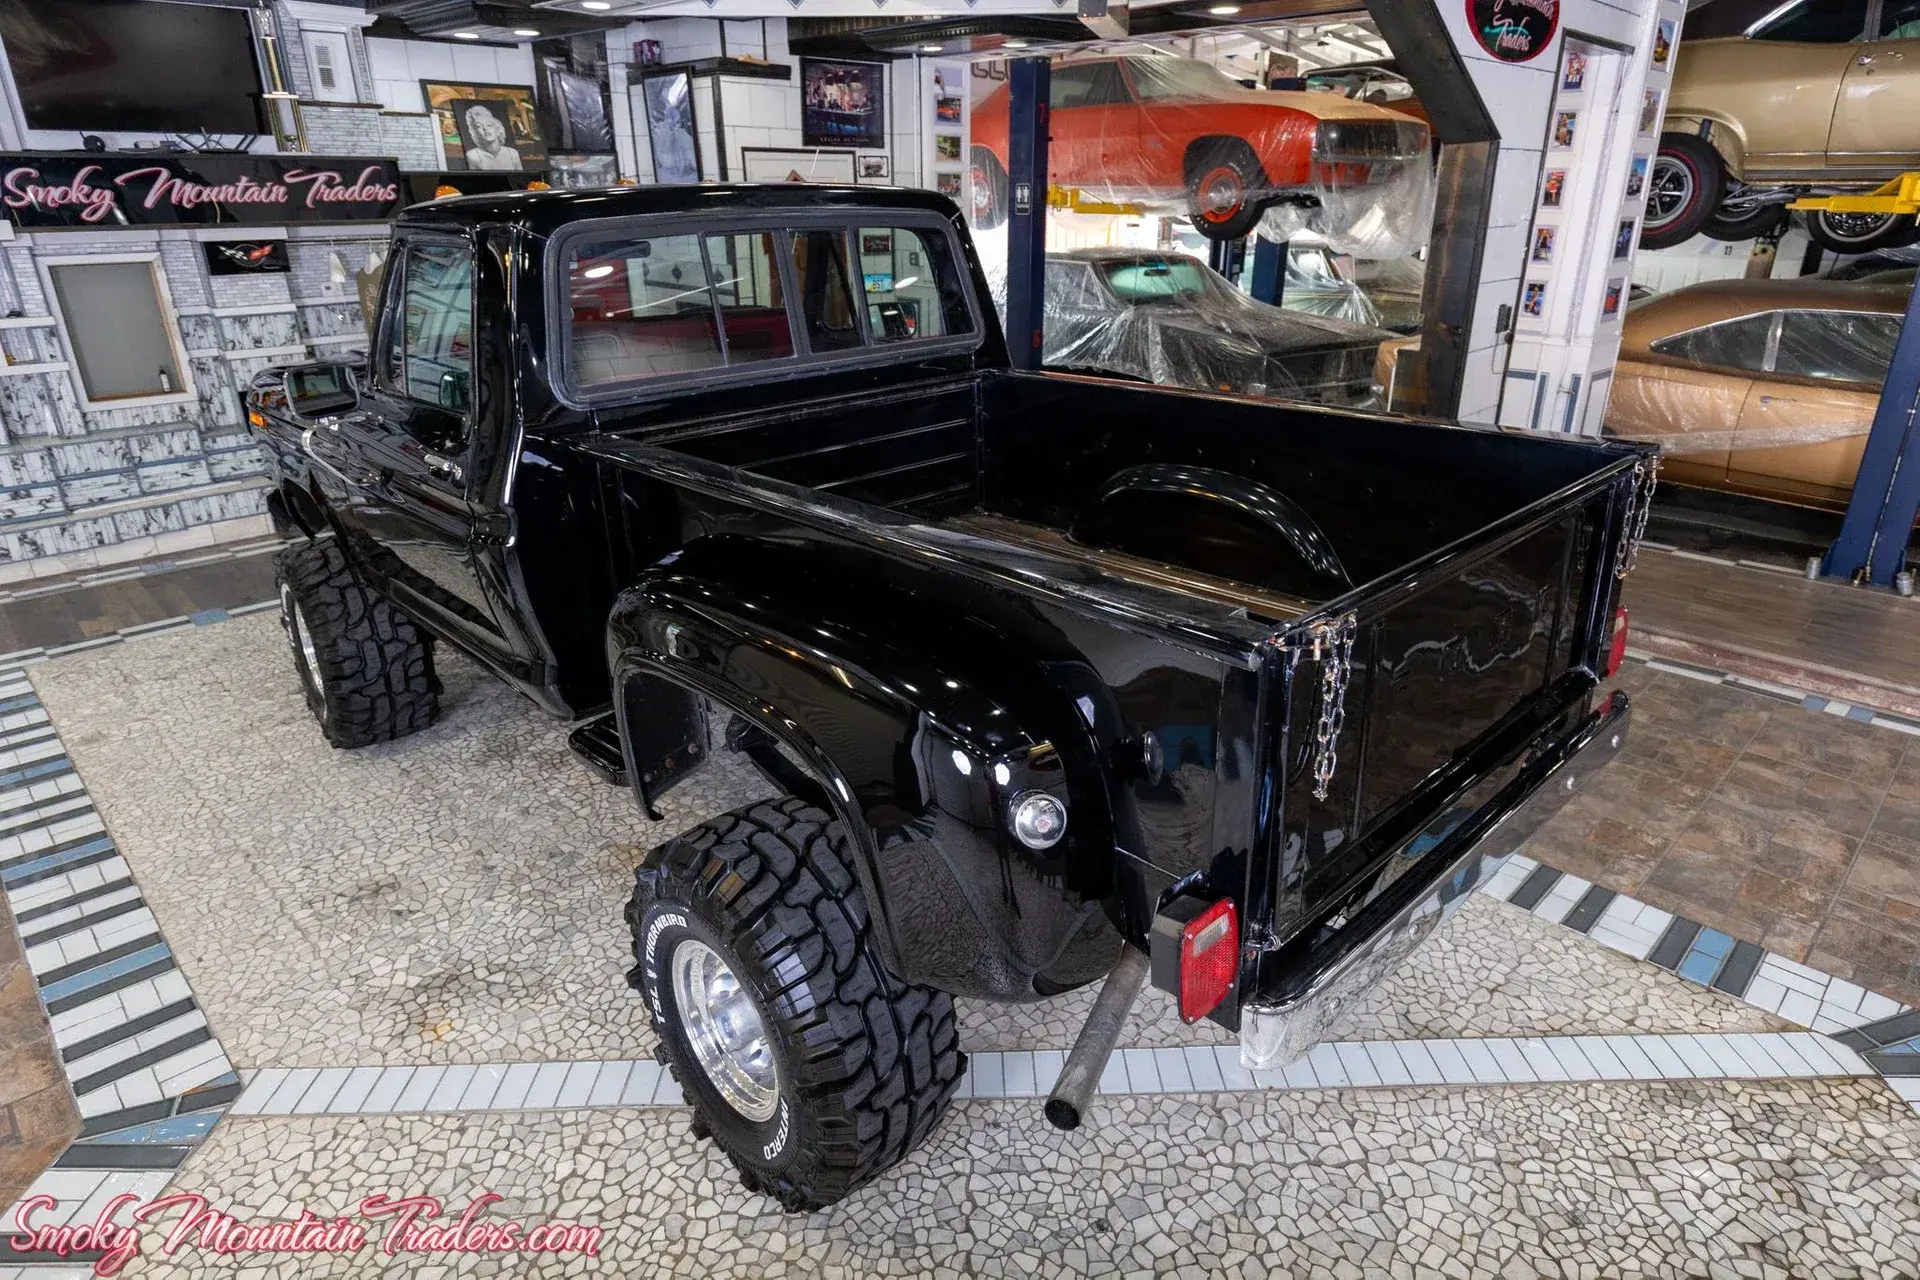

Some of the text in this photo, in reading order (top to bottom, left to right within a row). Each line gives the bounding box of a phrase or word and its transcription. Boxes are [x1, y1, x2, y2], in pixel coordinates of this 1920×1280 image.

[1493, 14, 1532, 52] Traders
[4, 165, 399, 222] Smoky Mountain Traders
[645, 912, 688, 1025] TSL THORNBIRD
[763, 1096, 790, 1161] INTERCO
